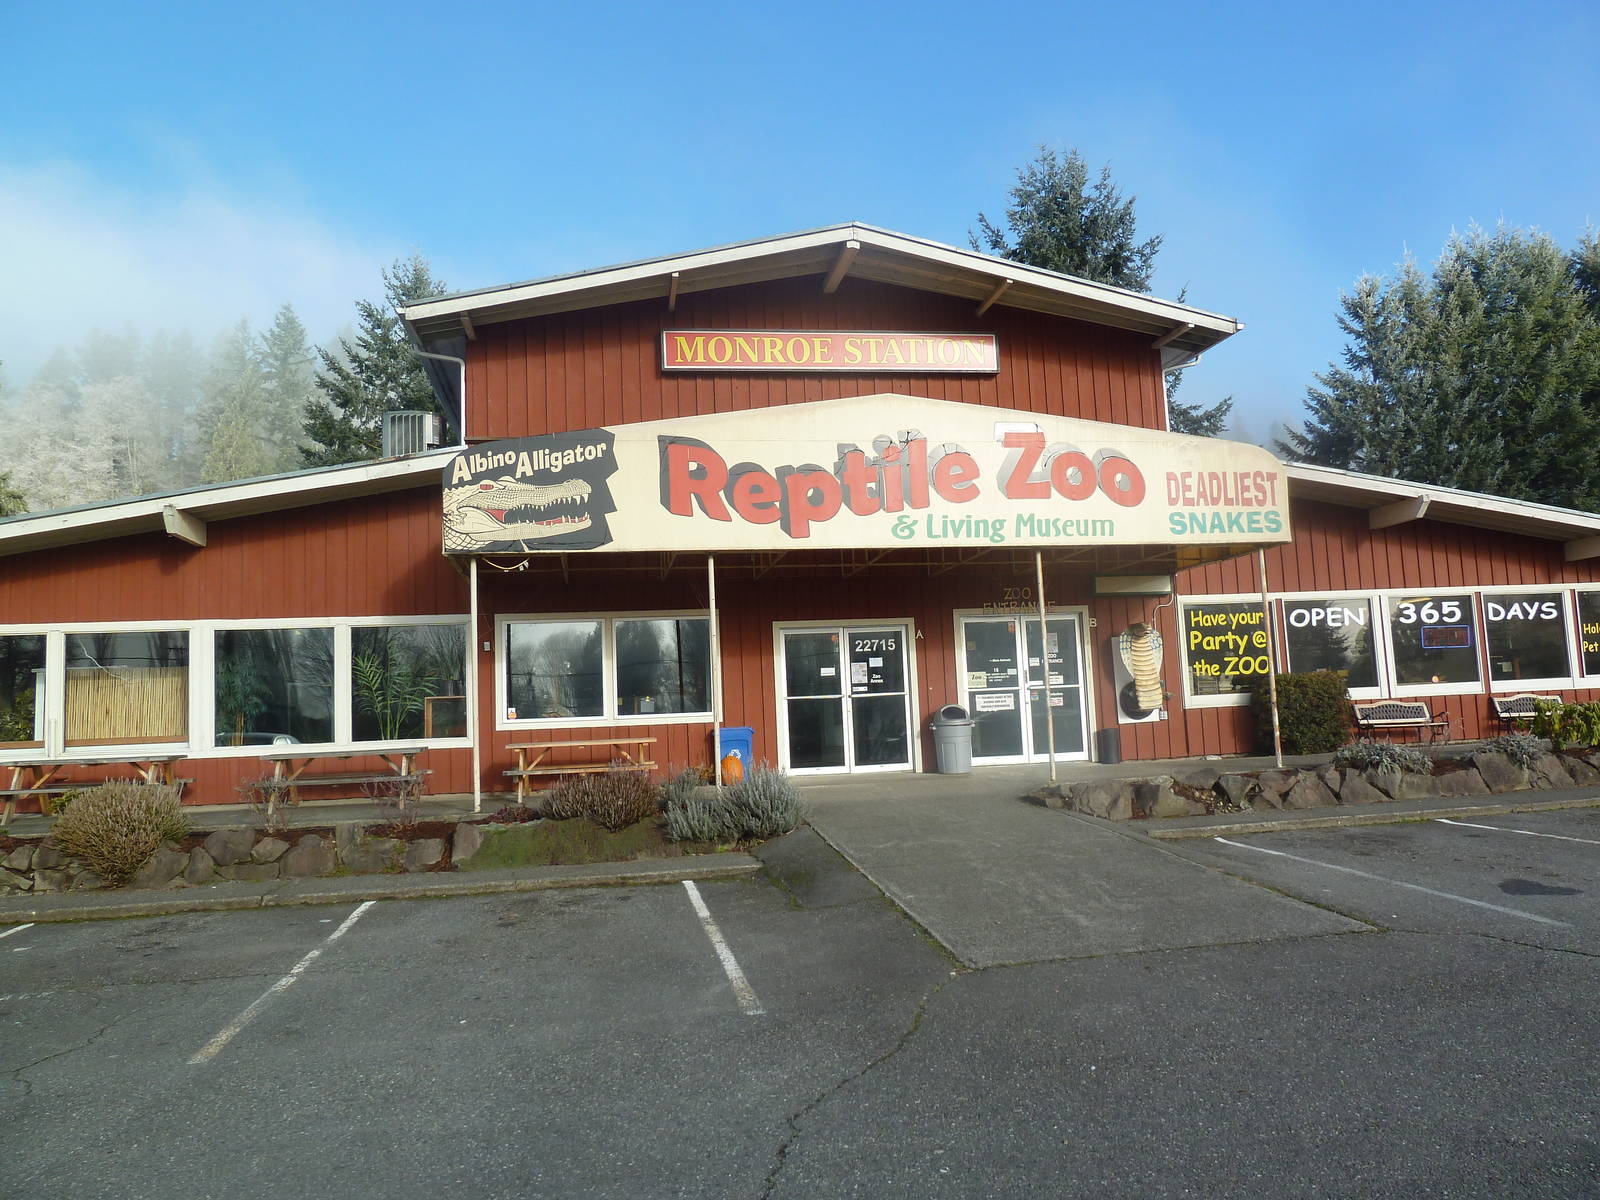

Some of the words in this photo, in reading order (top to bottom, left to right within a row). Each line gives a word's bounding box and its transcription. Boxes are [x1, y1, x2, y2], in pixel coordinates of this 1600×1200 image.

[674, 336, 834, 364] MONROE
[843, 337, 988, 365] STATION
[452, 450, 517, 485] Albino
[515, 442, 607, 479] Alligator
[660, 431, 980, 539] Reptile
[998, 426, 1146, 508] Zoo
[1166, 471, 1278, 507] DEADLIEST
[891, 514, 917, 540] &
[926, 514, 1005, 543] Living
[1015, 513, 1115, 538] Museum
[1169, 510, 1282, 535] SNAKES
[1003, 586, 1032, 600] ZOO
[1089, 617, 1098, 628] B
[1190, 610, 1227, 627] Have
[1229, 612, 1264, 630] your
[1289, 607, 1365, 627] OPEN
[1398, 601, 1462, 624] 365
[1488, 602, 1558, 621] DAYS
[915, 629, 924, 639] A
[1583, 622, 1600, 634] Hol
[855, 638, 896, 652] 22715
[1190, 630, 1249, 655] Party
[1252, 631, 1267, 648] @
[1583, 640, 1599, 653] Pet
[1193, 659, 1221, 677] the
[1223, 655, 1270, 676] ZOO
